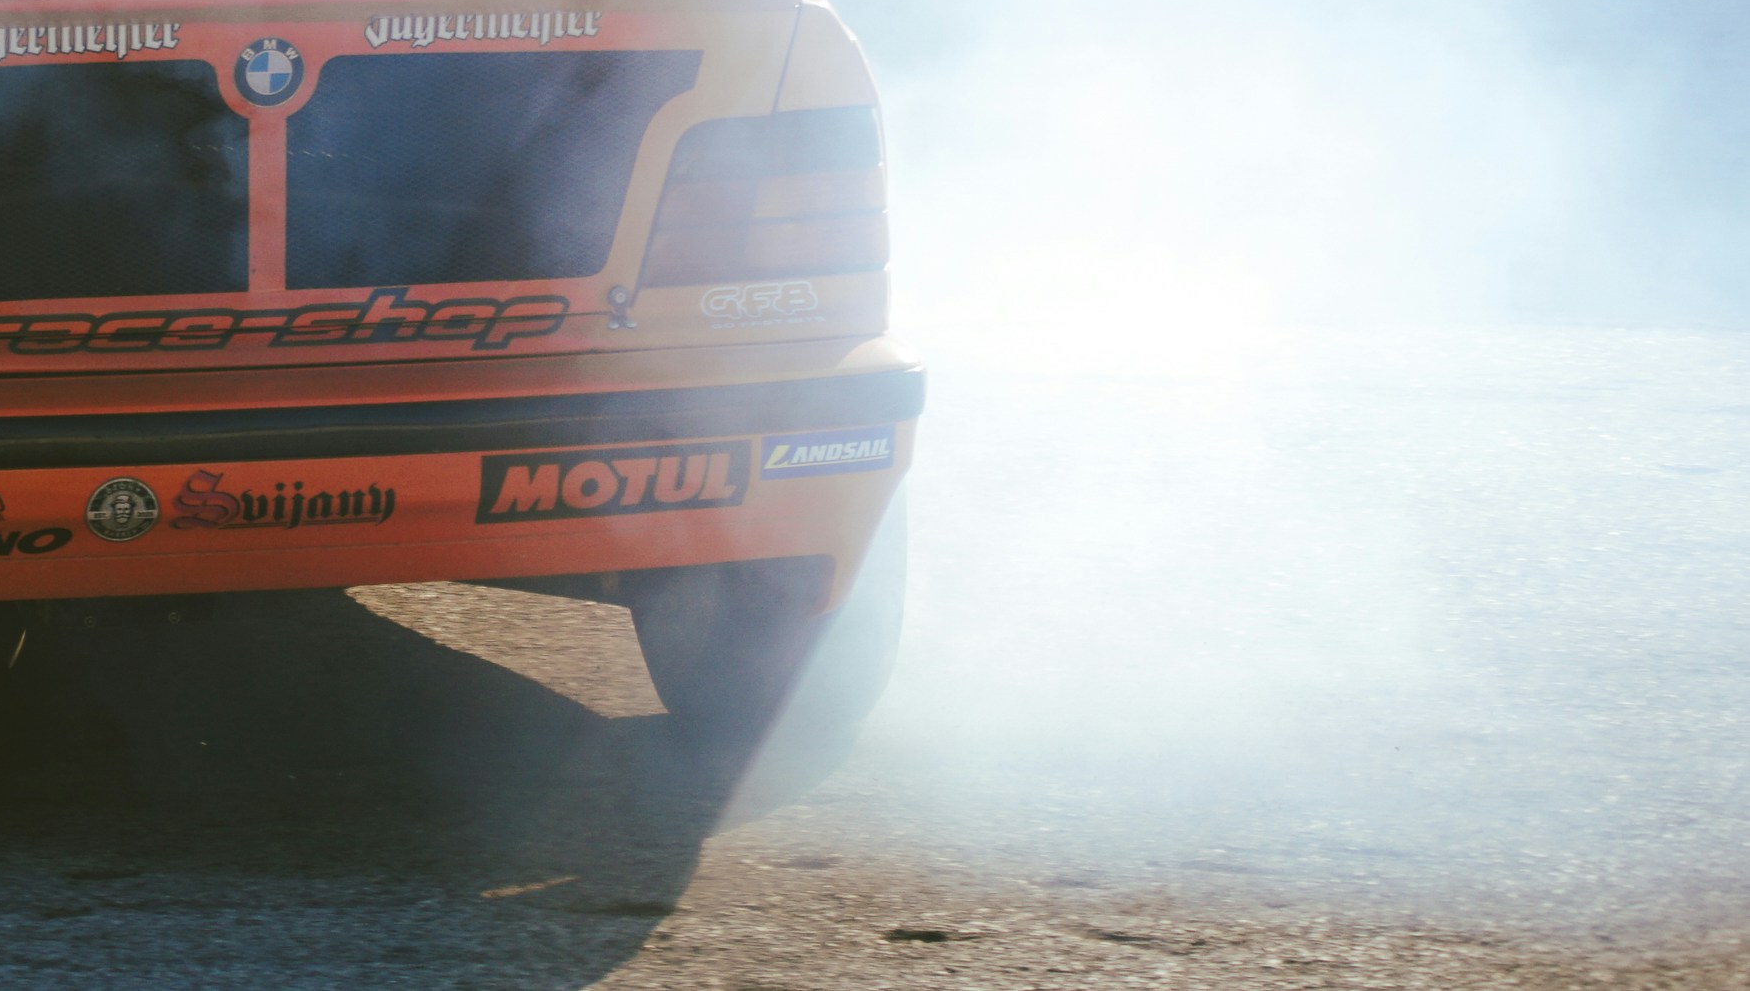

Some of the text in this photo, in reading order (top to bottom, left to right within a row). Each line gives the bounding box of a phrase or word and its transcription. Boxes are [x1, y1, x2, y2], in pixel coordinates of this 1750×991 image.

[241, 39, 299, 61] BMW
[764, 438, 891, 469] LANDSAIL
[170, 469, 396, 529] Svijany
[490, 454, 737, 514] MOTUL
